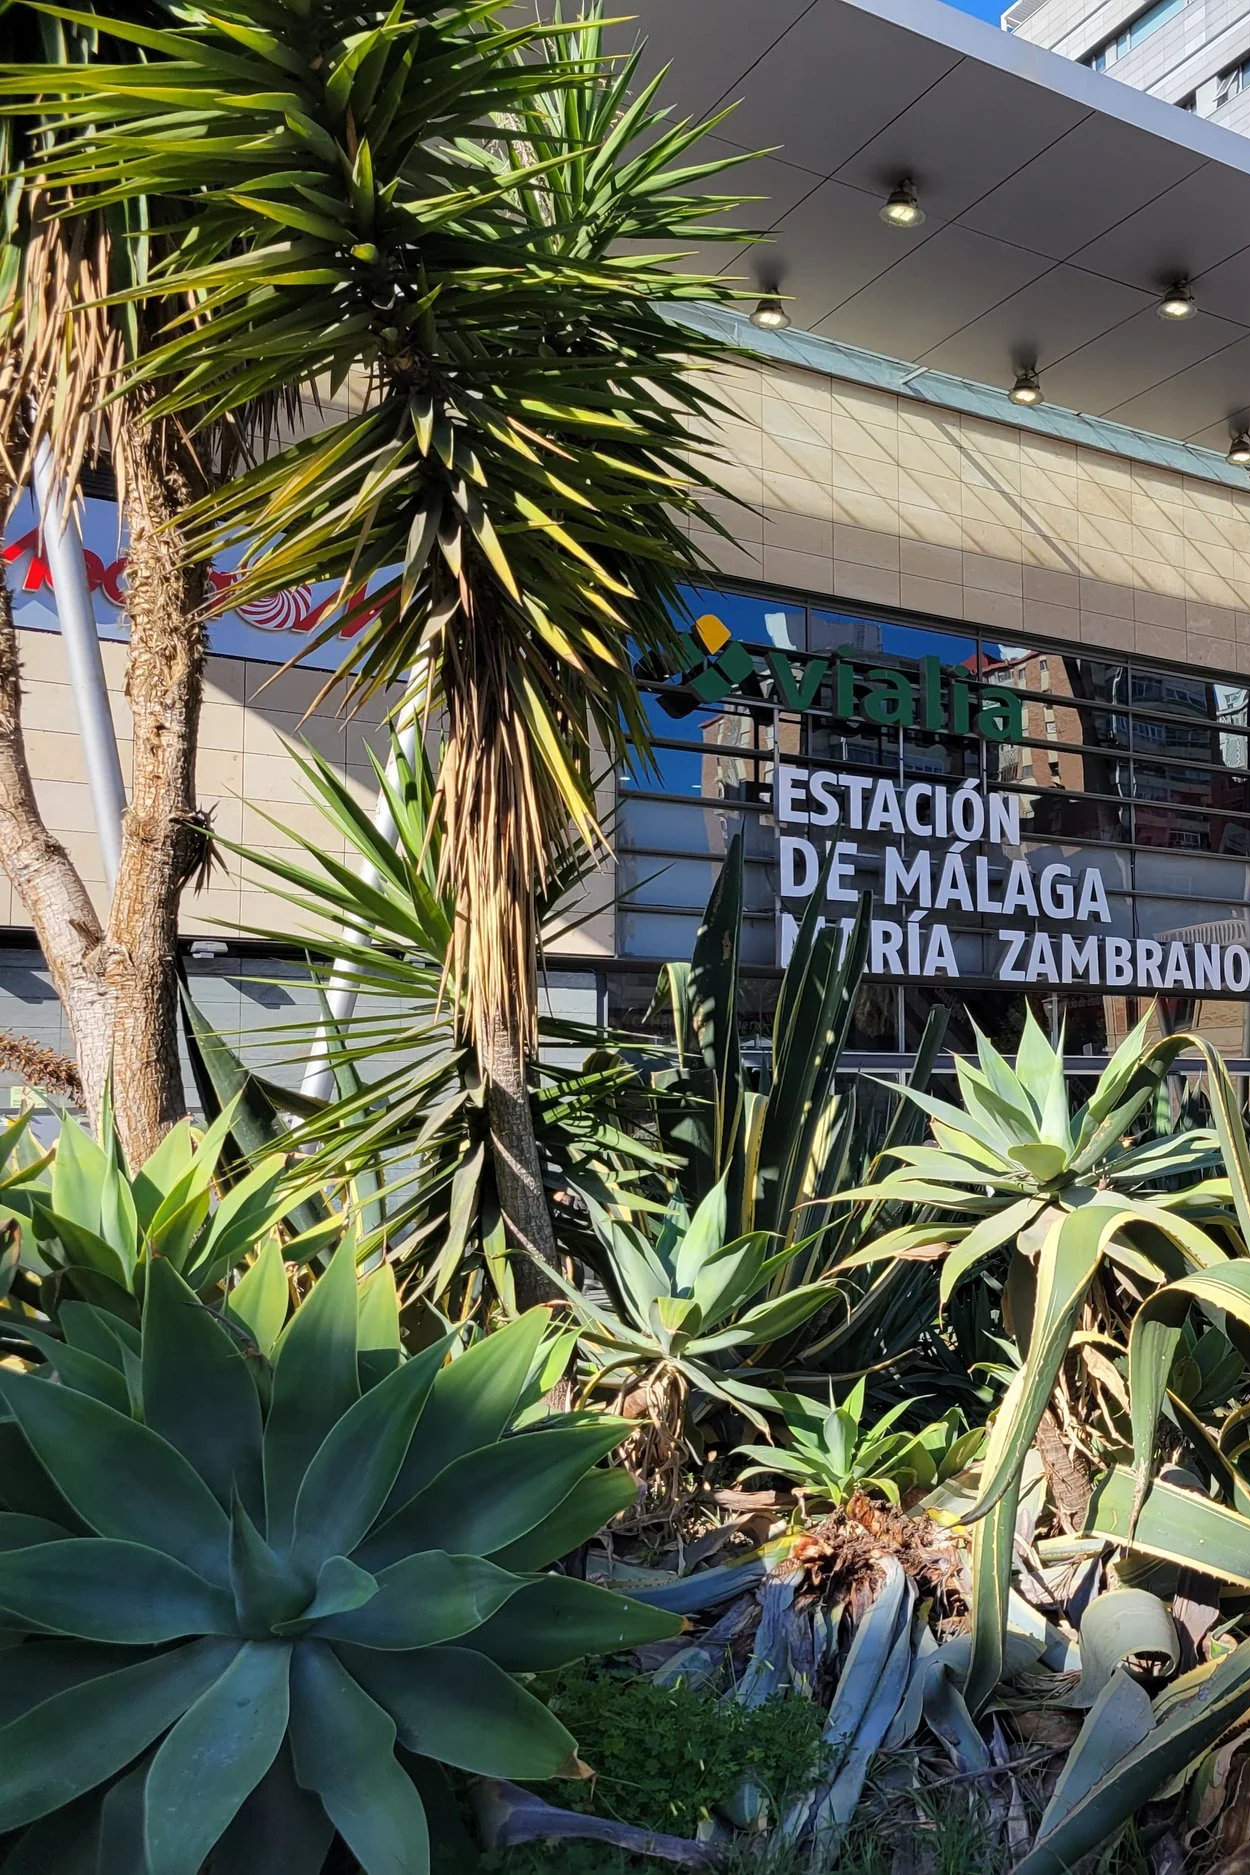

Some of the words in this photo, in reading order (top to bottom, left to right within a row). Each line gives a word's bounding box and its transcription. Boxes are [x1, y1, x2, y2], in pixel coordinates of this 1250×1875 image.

[764, 643, 1023, 741] vialia
[778, 766, 1021, 846] ESTACIÓN
[779, 836, 859, 902] DE
[884, 841, 1112, 923] MÁLAGA
[999, 929, 1250, 993] ZAMBRANO
